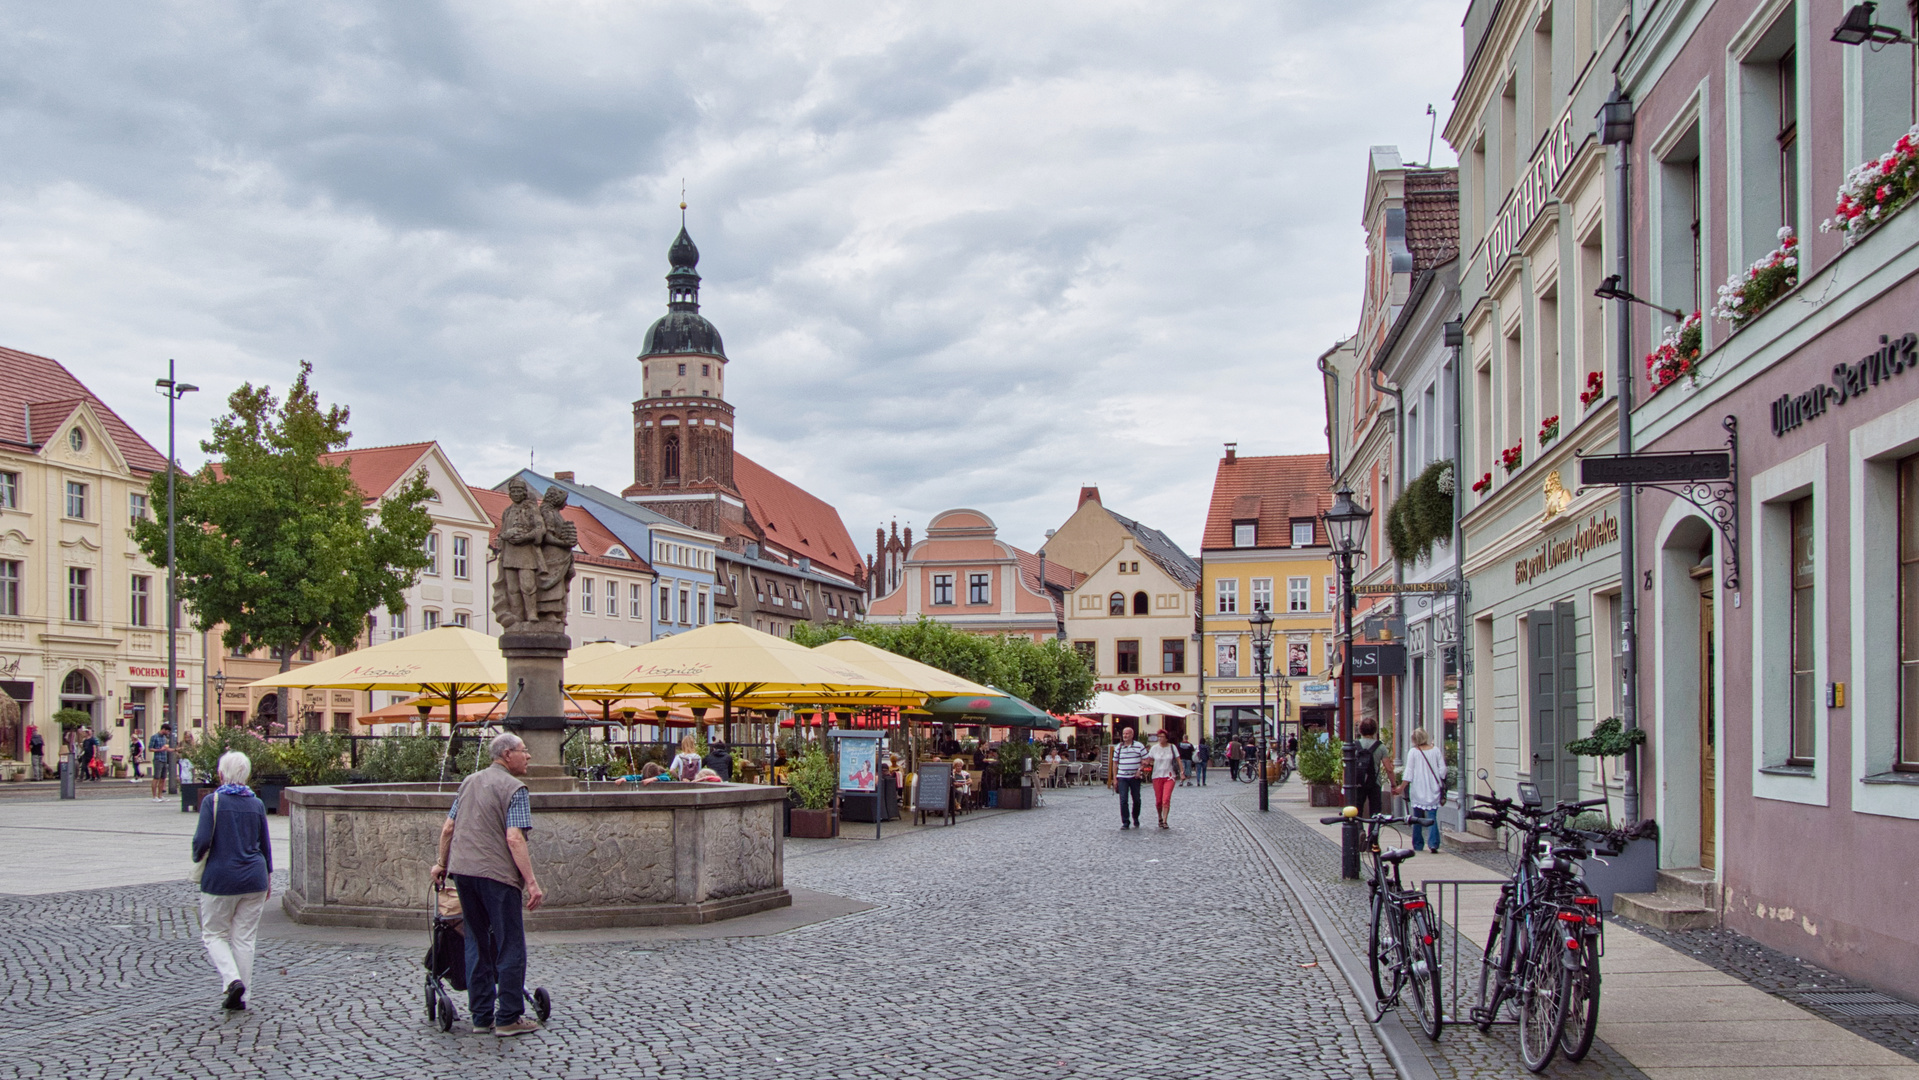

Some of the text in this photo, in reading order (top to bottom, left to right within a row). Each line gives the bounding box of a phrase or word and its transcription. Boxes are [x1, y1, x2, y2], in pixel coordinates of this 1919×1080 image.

[1485, 110, 1575, 287] APOTHEKE
[1770, 332, 1918, 437] Uhren-Service
[1547, 537, 1572, 570] Löwen
[1352, 583, 1448, 594] POTHEKENMUSEUM
[1352, 657, 1362, 668] by
[1094, 678, 1181, 692] au & Bistro
